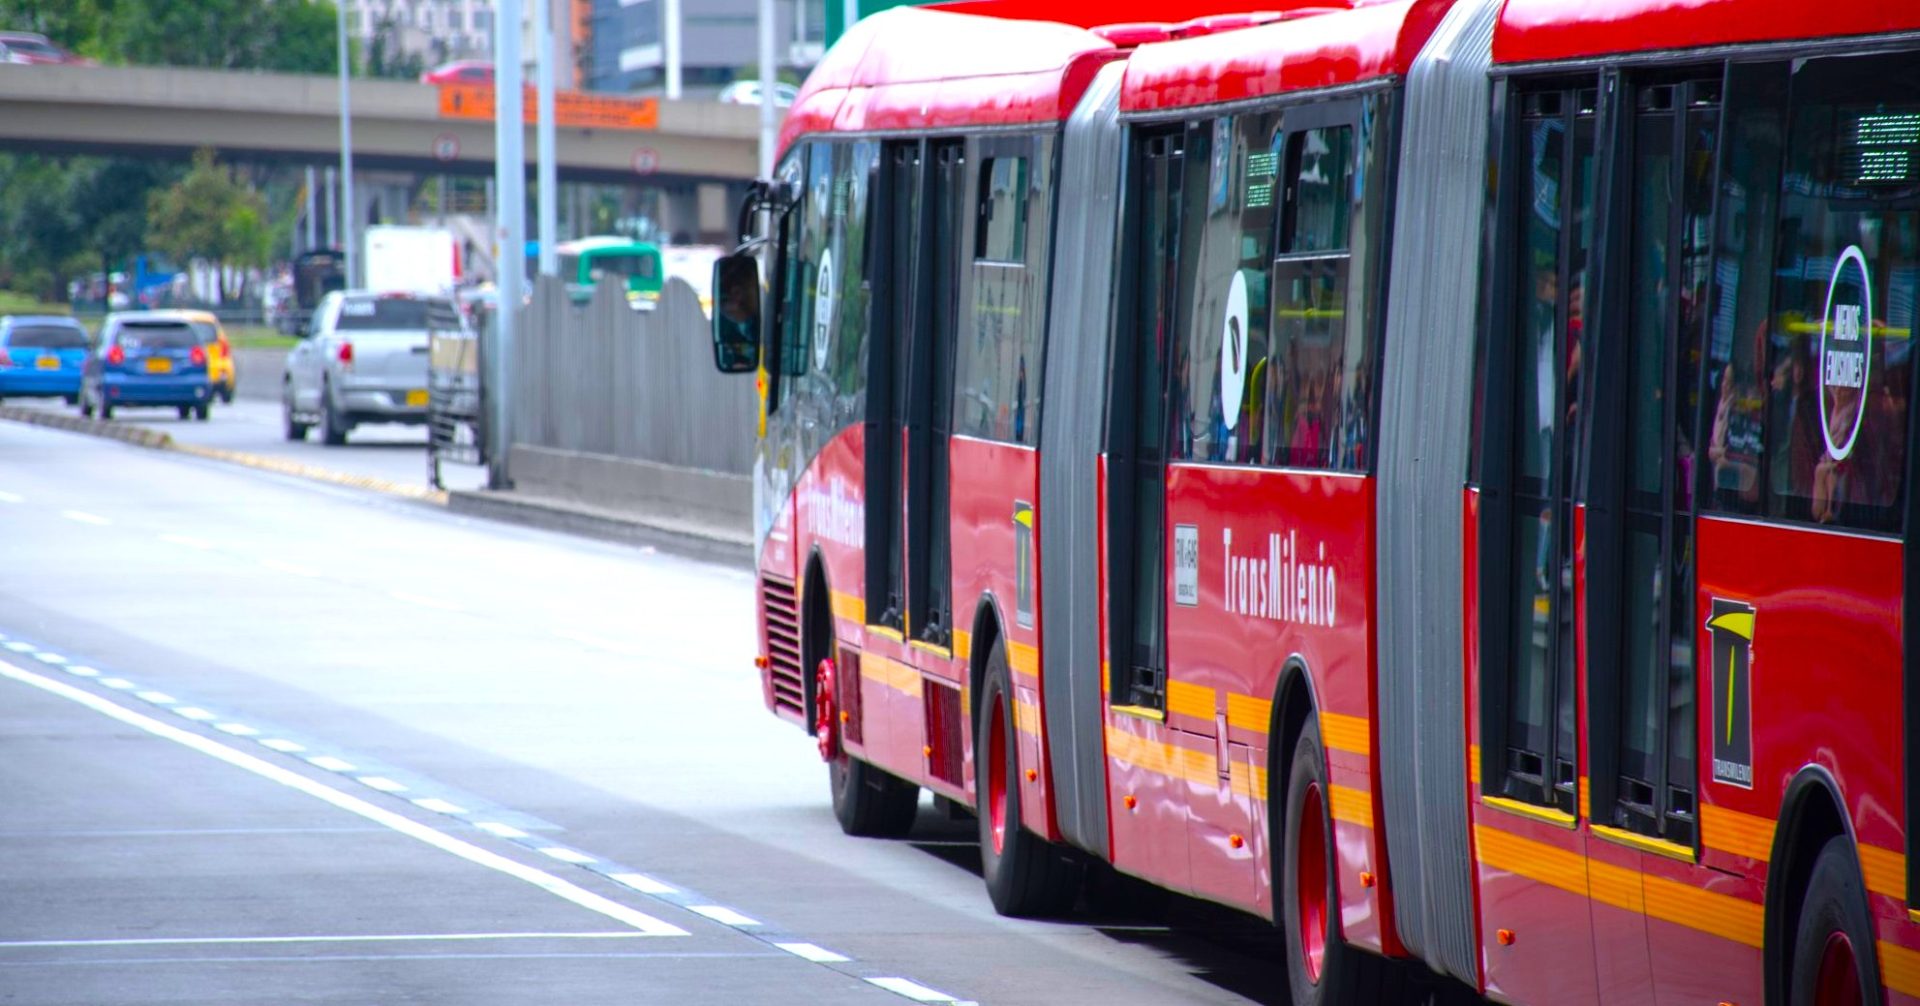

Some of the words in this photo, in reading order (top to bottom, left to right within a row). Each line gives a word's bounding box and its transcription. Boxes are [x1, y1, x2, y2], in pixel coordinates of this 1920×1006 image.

[1834, 304, 1861, 341] MENOS
[1825, 350, 1864, 389] EMISIONES
[1223, 527, 1336, 628] TransMilenio
